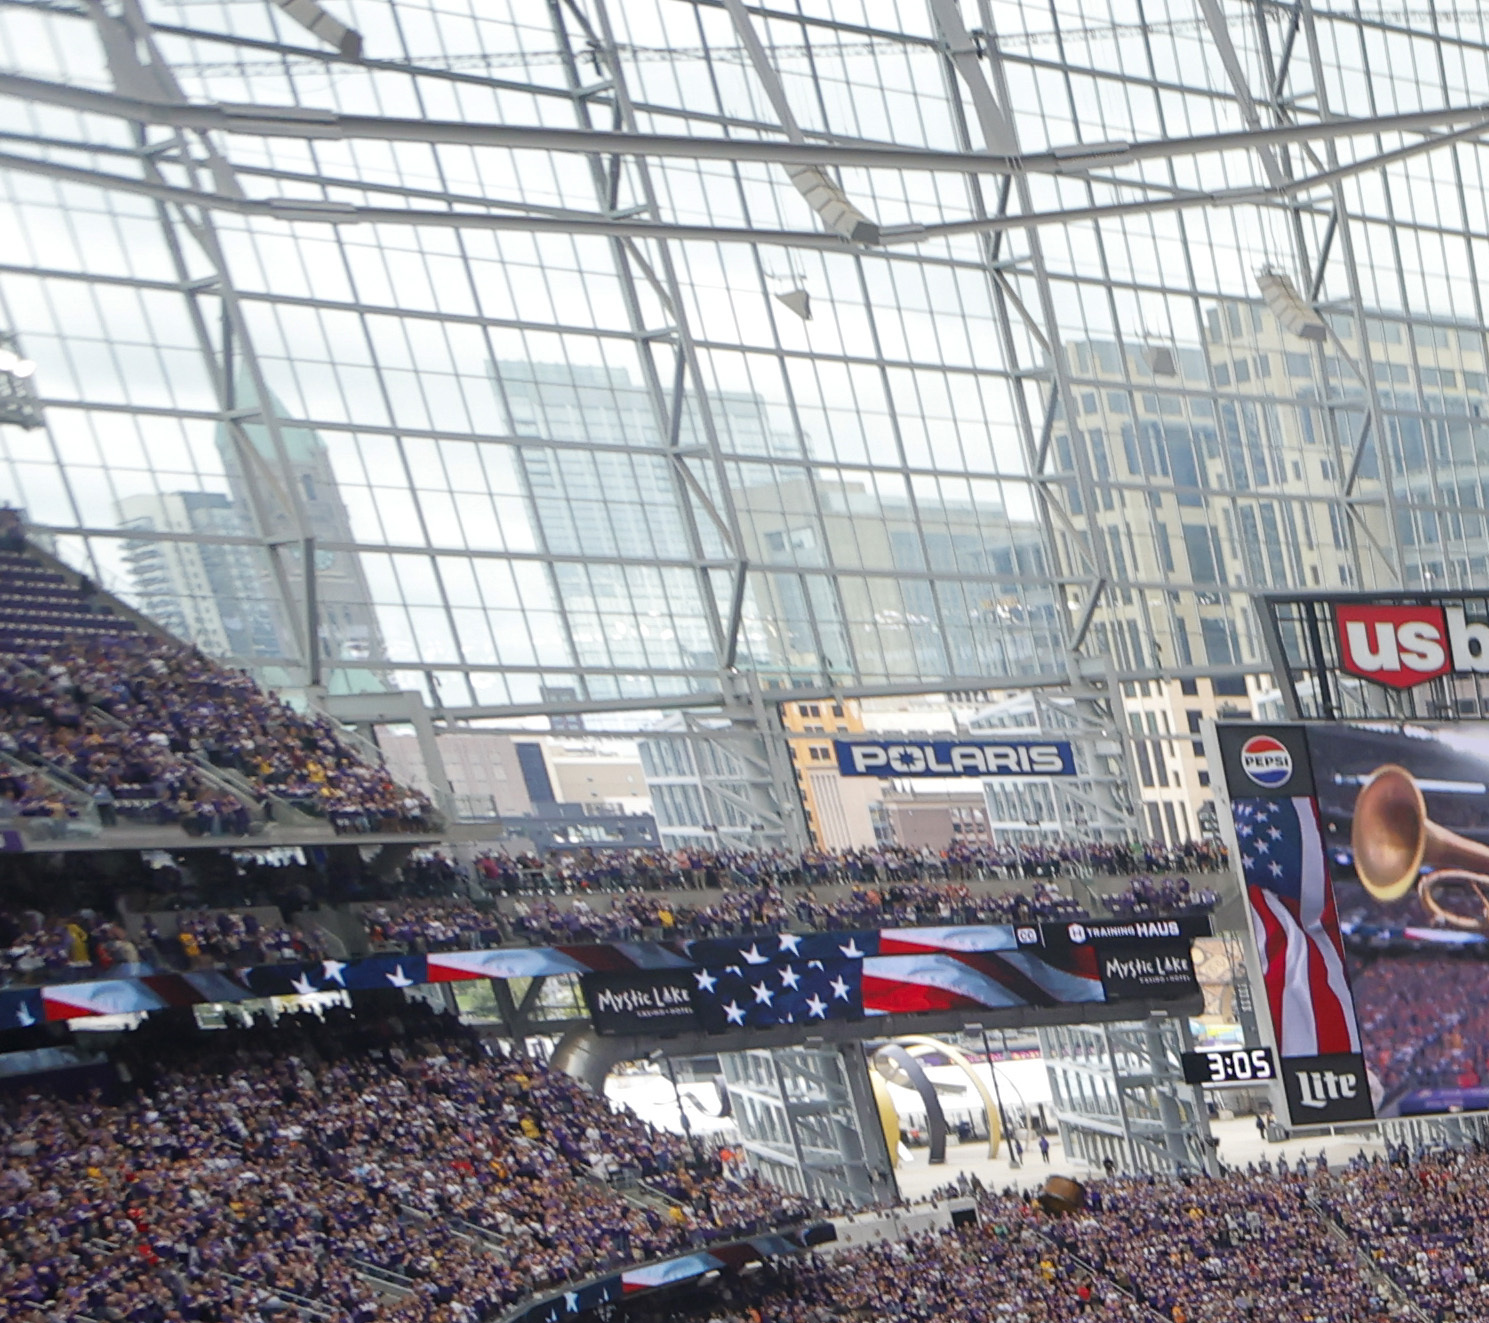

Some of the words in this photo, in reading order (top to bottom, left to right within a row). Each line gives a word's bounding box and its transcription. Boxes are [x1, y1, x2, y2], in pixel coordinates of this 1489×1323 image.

[851, 745, 1064, 773] POLARIS
[1244, 755, 1289, 769] PEPSI
[1087, 926, 1136, 938] TRAINING
[1137, 922, 1180, 938] HAUS
[1207, 1049, 1271, 1081] 3:05
